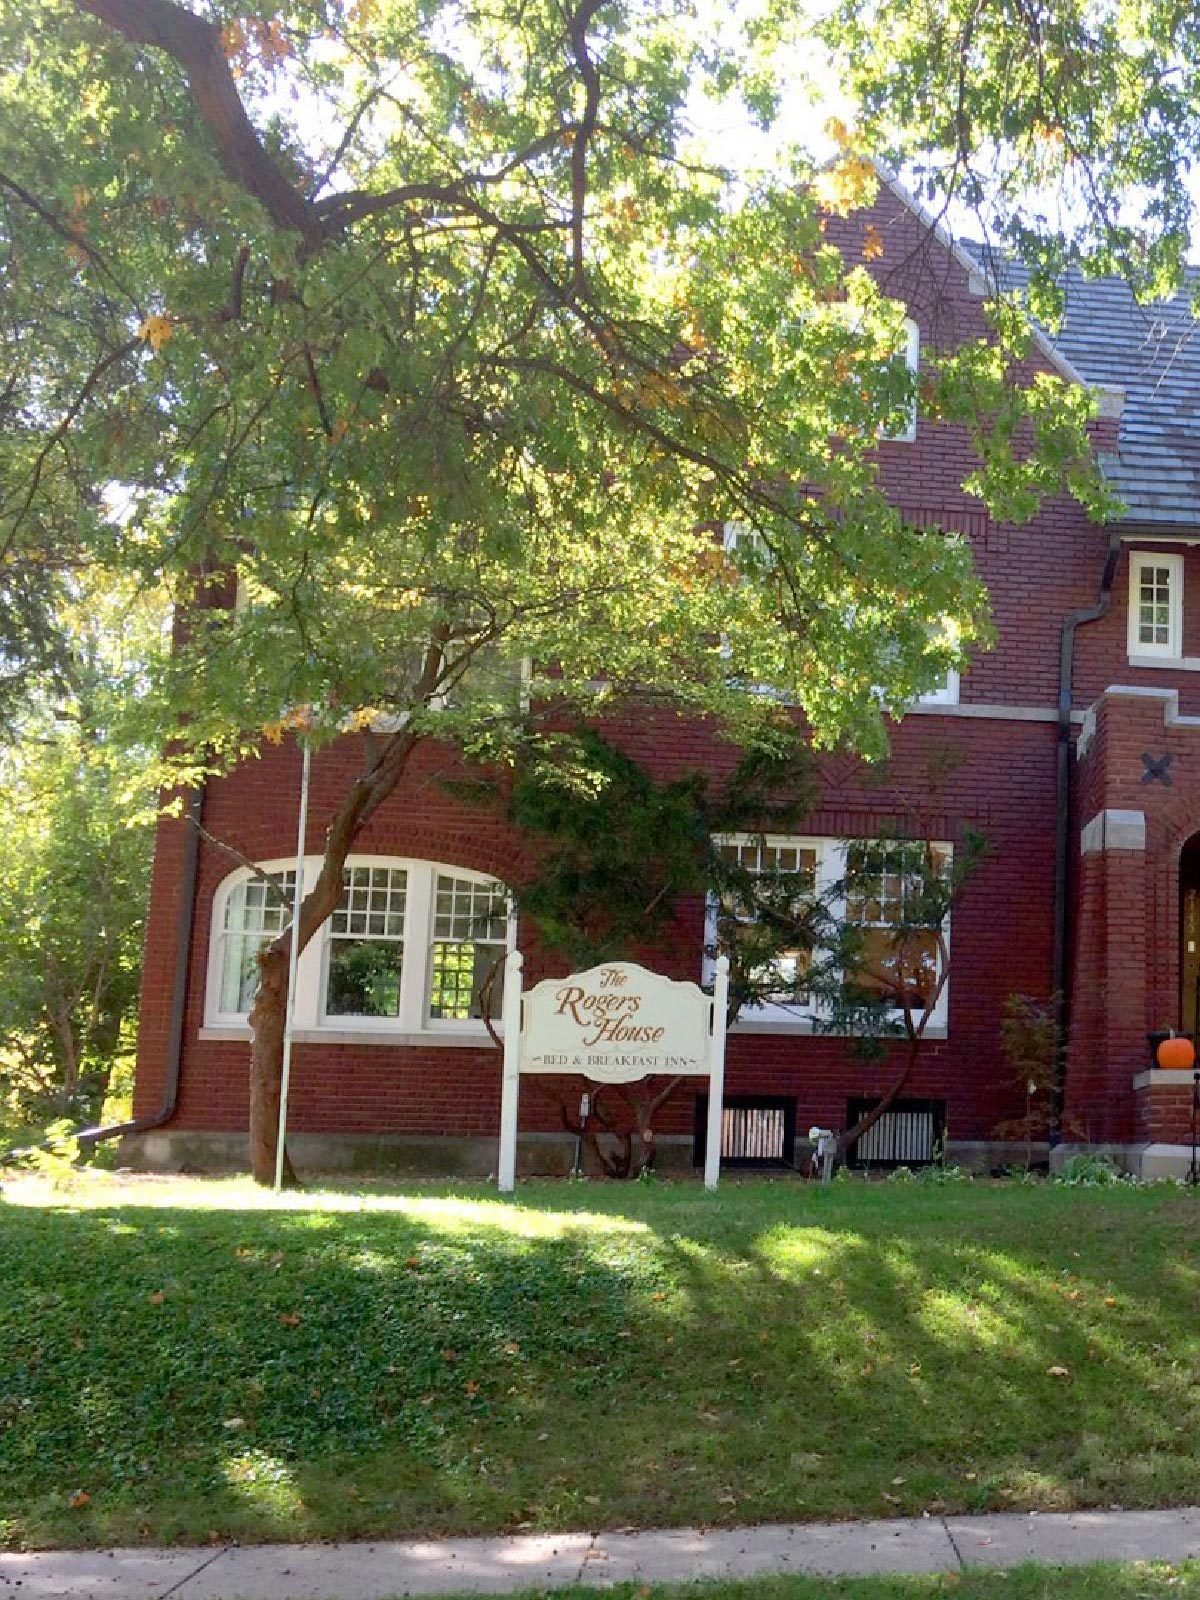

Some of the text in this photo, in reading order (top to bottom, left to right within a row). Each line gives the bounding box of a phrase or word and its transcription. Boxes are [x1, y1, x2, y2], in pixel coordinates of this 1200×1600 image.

[600, 969, 628, 988] The
[554, 987, 641, 1026] Rogers
[582, 1013, 665, 1046] House
[572, 1055, 582, 1065] &
[587, 1055, 658, 1065] BREAKFAST
